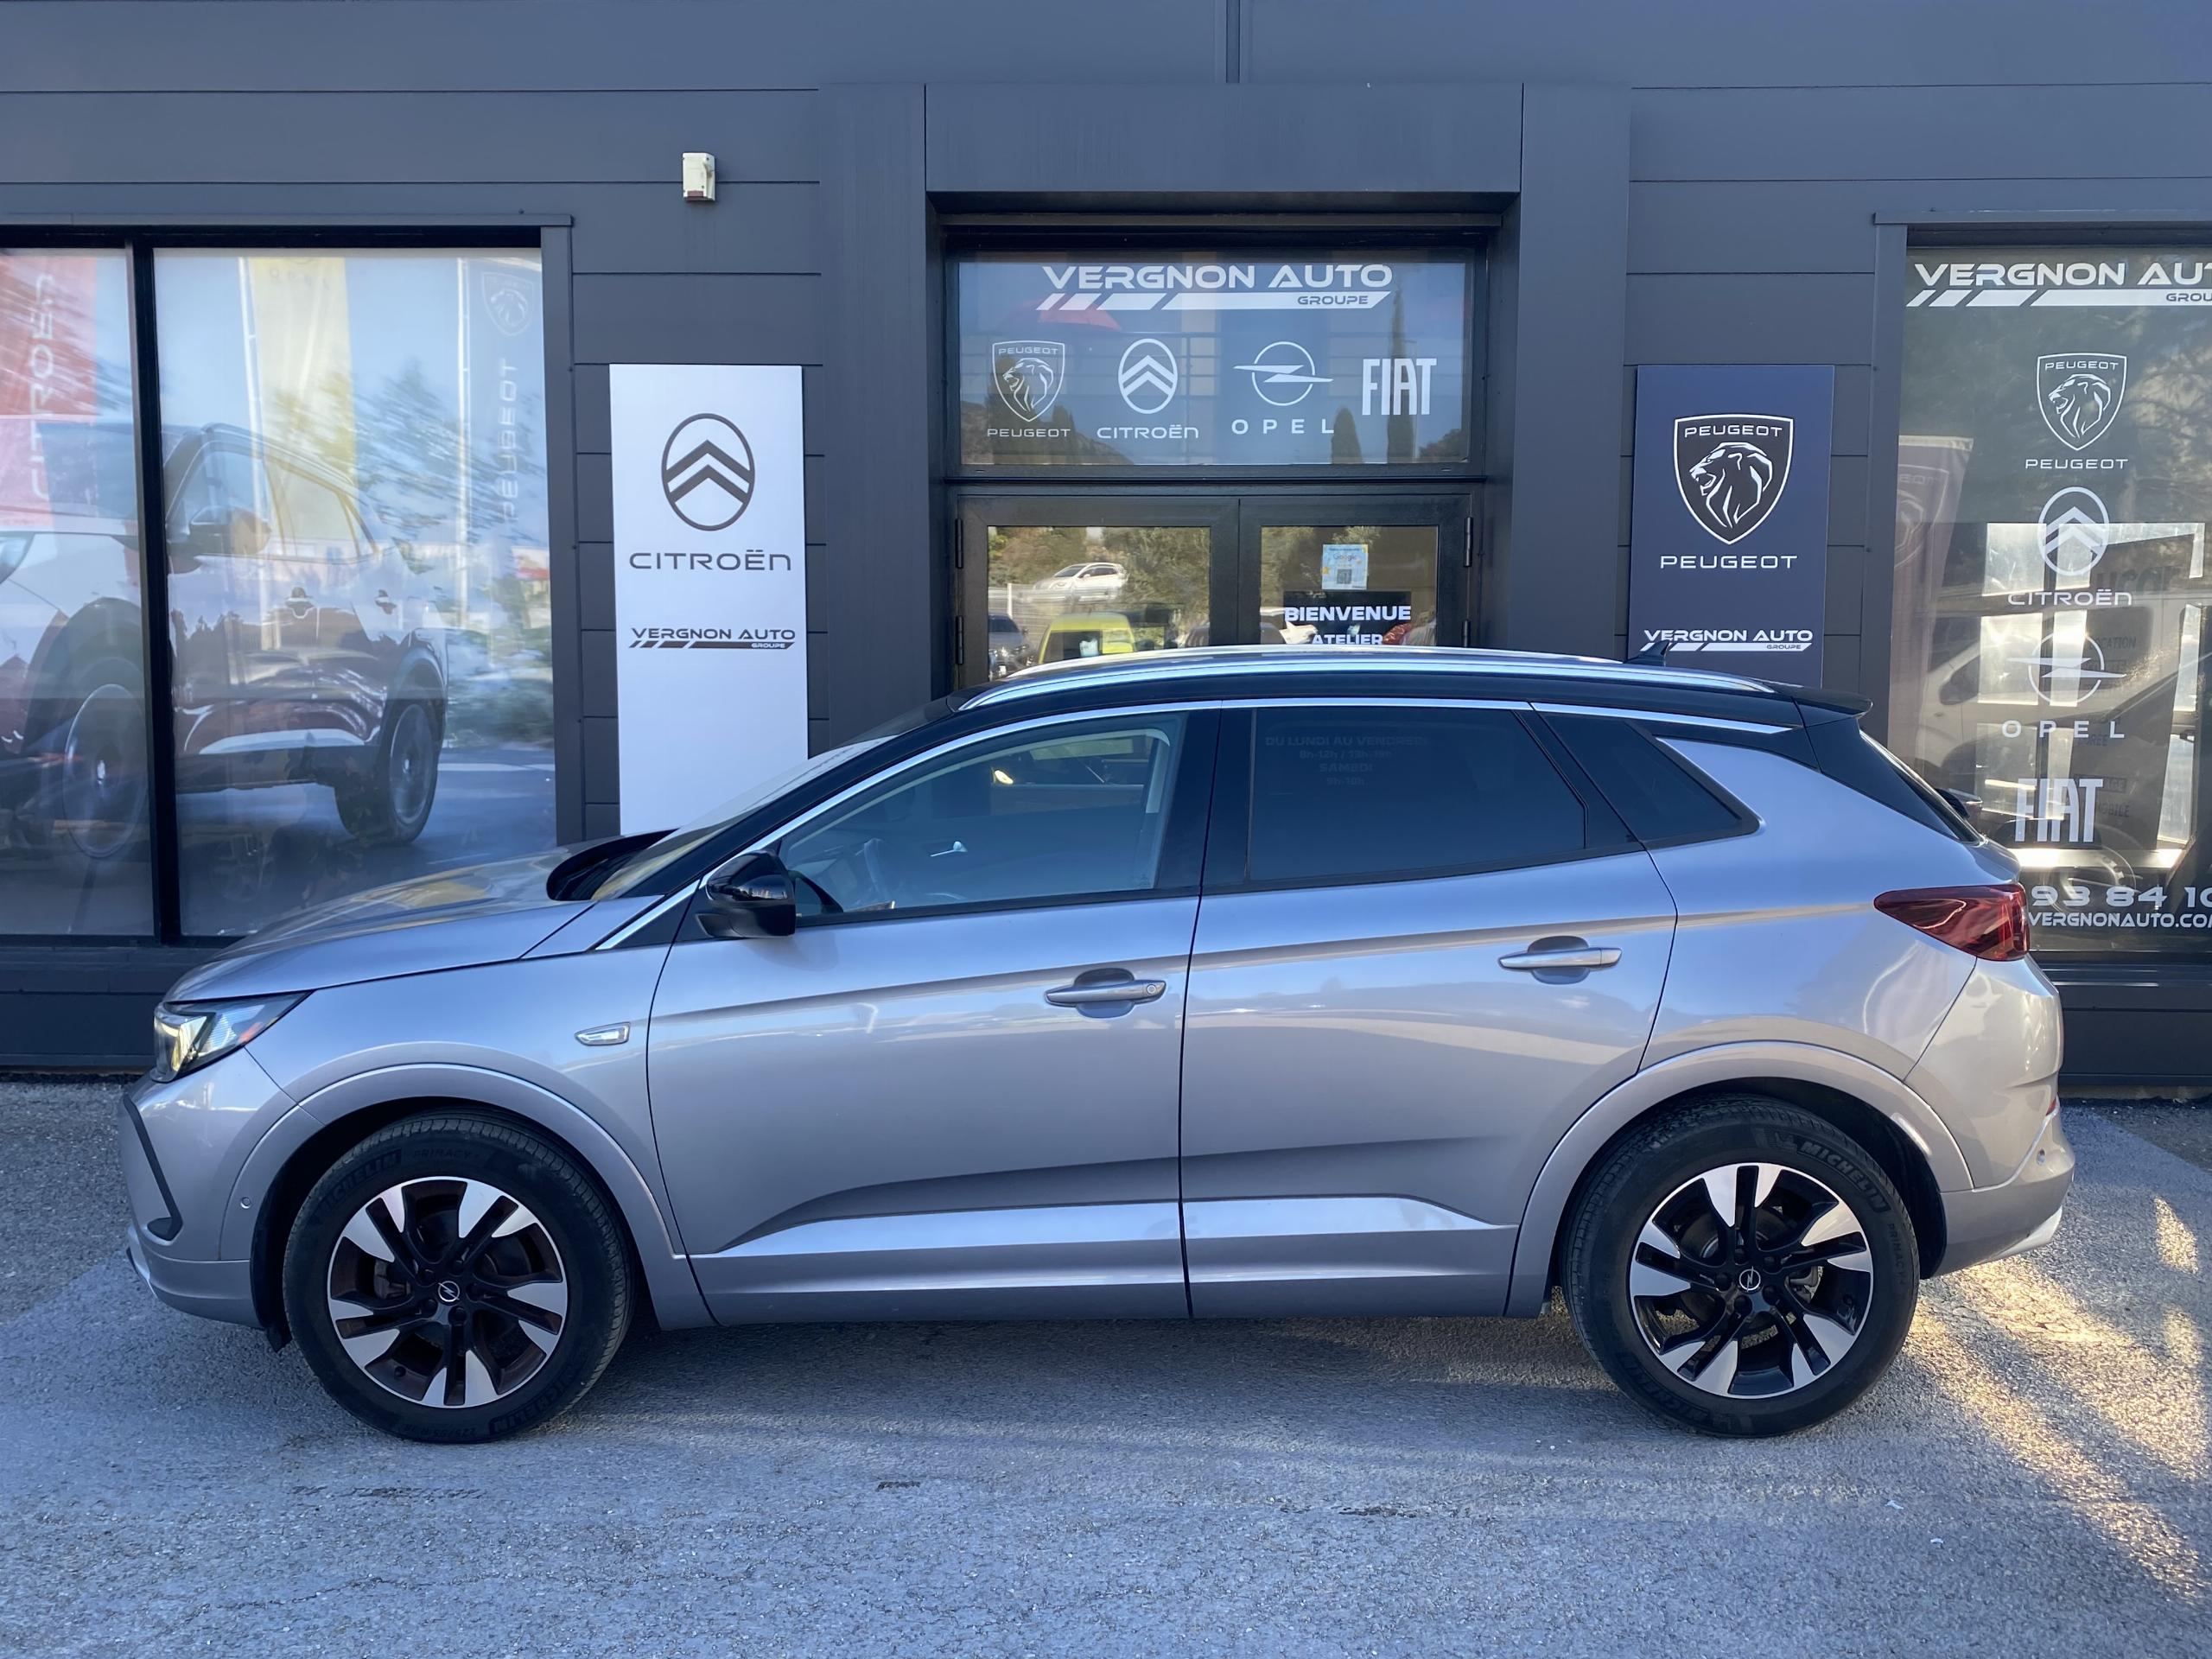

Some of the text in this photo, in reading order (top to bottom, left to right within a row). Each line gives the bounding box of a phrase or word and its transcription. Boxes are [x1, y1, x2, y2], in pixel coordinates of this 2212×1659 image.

[1042, 264, 1392, 289] VERGNON AUTO
[1914, 263, 2126, 286] VERGNON
[1297, 296, 1369, 305] GROUPE
[999, 346, 1058, 355] PEUGEOT
[2044, 361, 2119, 371] PEUGEOT
[1362, 358, 1437, 416] FIAT
[987, 429, 1070, 437] PEUGEOT
[1097, 424, 1198, 439] CITROËN
[1231, 419, 1334, 435] OPEL
[1684, 424, 1783, 438] PEUGEOT
[2024, 459, 2127, 469] PEUGEOT
[629, 549, 791, 570] CITROËN
[1661, 556, 1796, 569] PEUGEOT
[2008, 588, 2132, 606] CITROËN
[1284, 607, 1411, 621] BIENVENUE
[632, 628, 796, 639] VERGNON AUTO
[1313, 634, 1382, 645] ATELIER
[1644, 629, 1813, 642] VERGNON AUTO
[2002, 721, 2125, 739] OPEL
[2015, 778, 2103, 842] FIAT
[2031, 886, 2090, 906] 93
[2105, 886, 2167, 908] 84
[2029, 912, 2212, 928] VERGNONAUTO.CO
